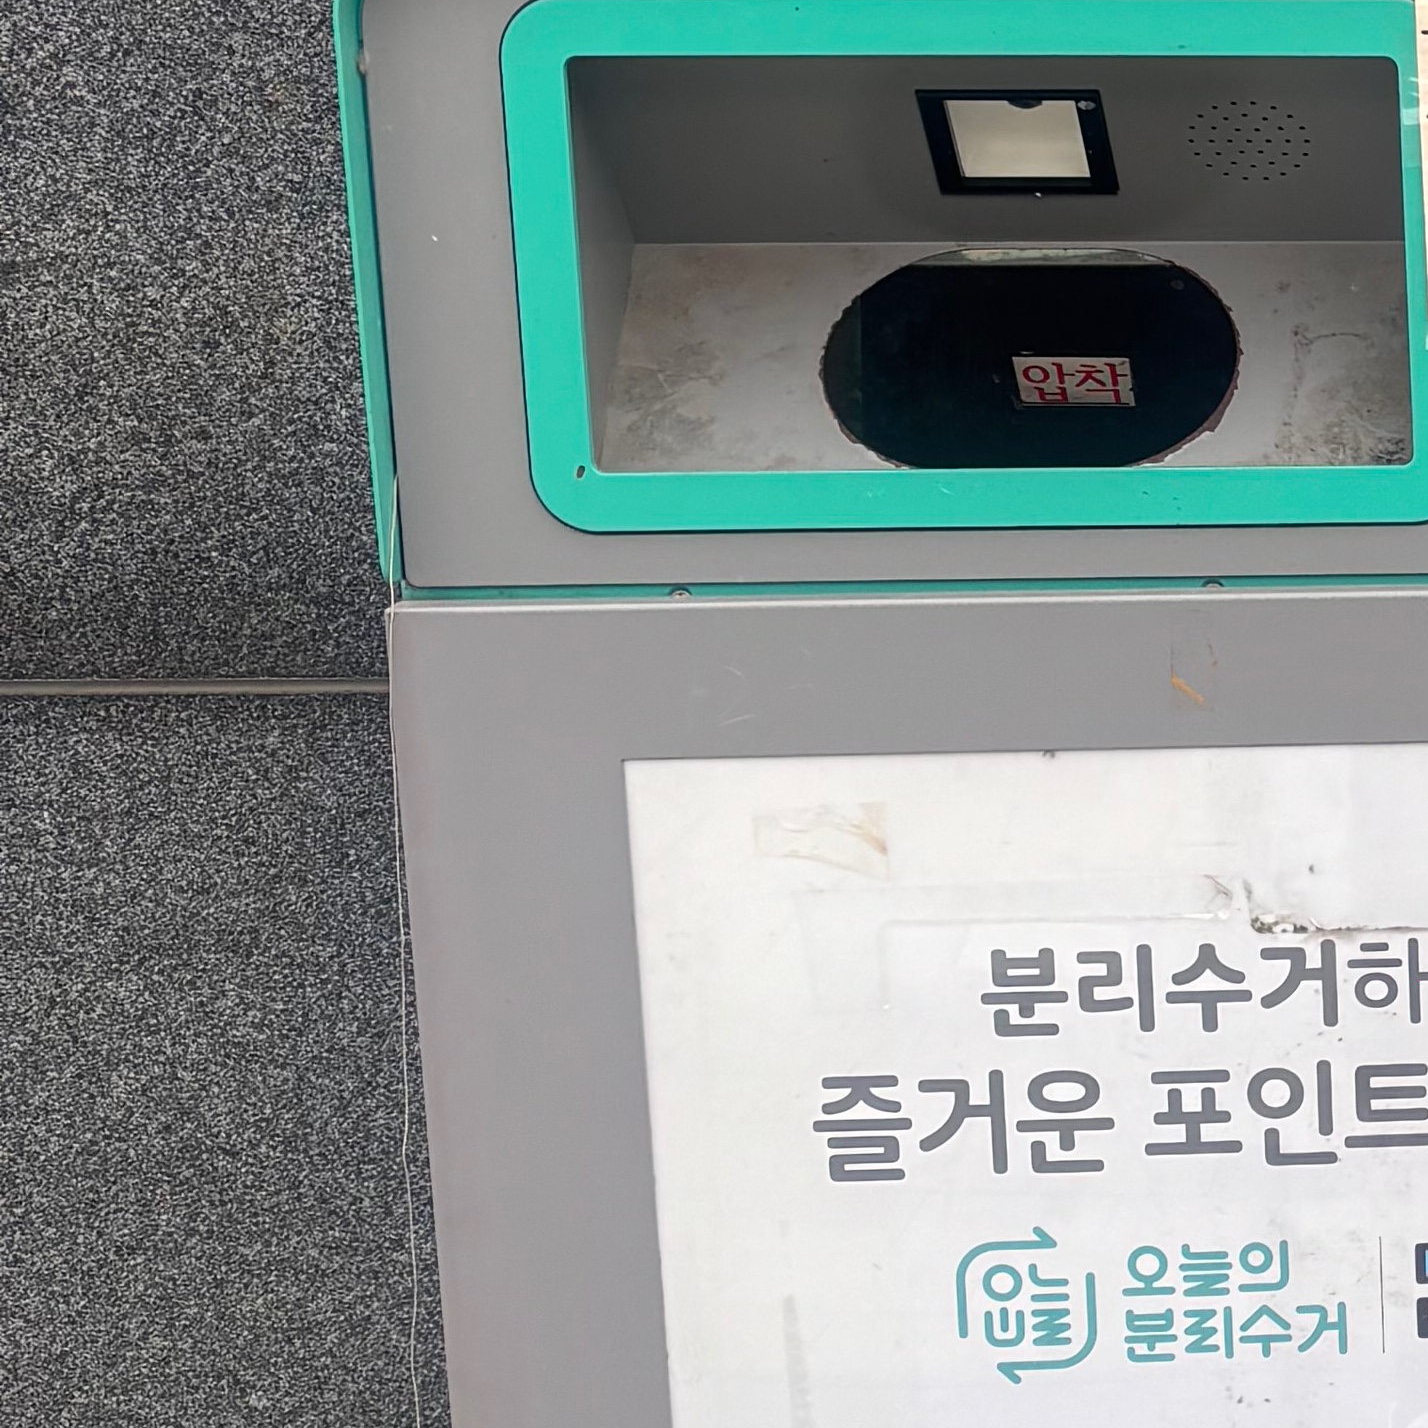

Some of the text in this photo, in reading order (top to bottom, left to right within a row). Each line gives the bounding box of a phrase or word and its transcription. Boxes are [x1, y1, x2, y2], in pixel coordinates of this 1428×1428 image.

[1022, 362, 1128, 404] 압착
[812, 1068, 1115, 1181] 즐거운
[1122, 1240, 1289, 1297] 오늘의
[1124, 1301, 1347, 1362] 분리수거
